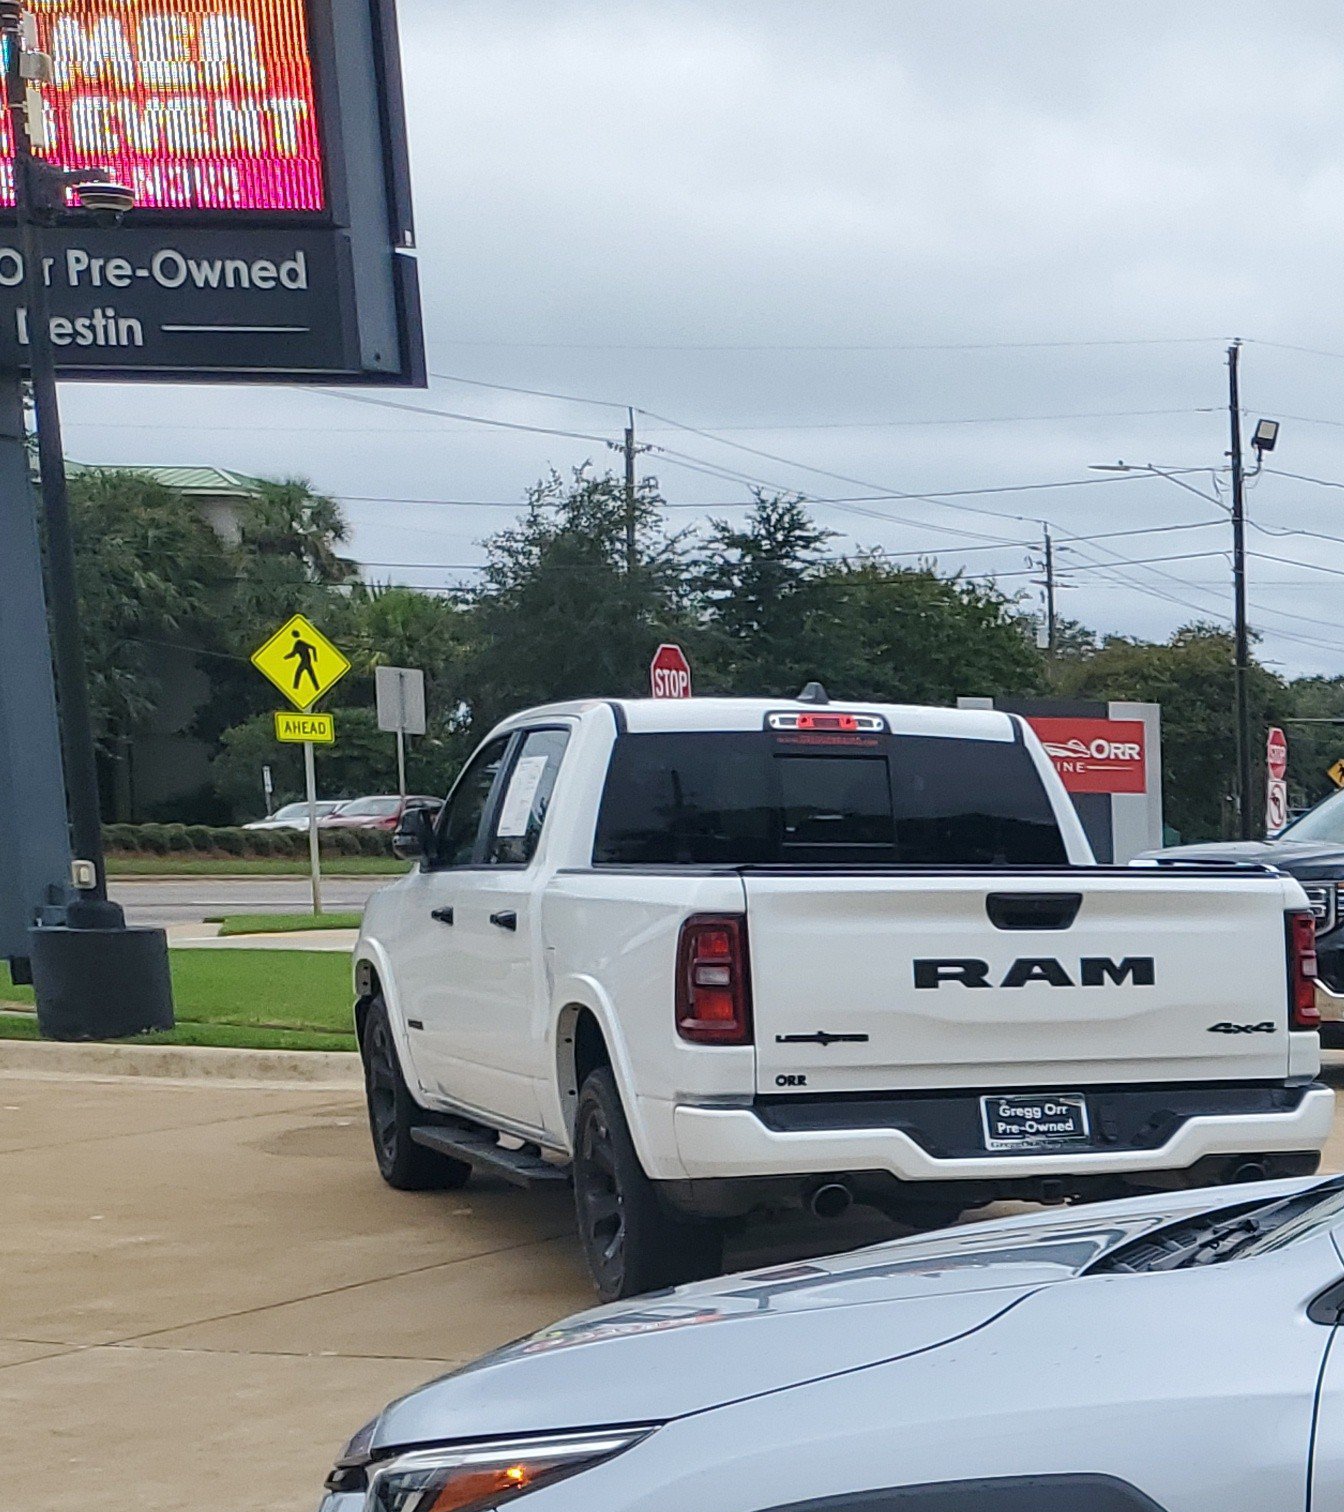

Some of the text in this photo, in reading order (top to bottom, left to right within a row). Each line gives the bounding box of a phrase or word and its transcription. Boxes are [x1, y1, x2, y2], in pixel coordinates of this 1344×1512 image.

[71, 95, 308, 155] EVENT
[0, 248, 308, 289] Or Pre-Owned
[655, 668, 688, 698] STOP
[284, 720, 327, 735] AHEAD
[1089, 738, 1141, 760] ORR
[1056, 761, 1086, 773] INE
[912, 956, 1156, 989] RAM
[1206, 1021, 1278, 1034] 4x4
[775, 1074, 807, 1087] ORR
[999, 1103, 1068, 1119] Gregg Orr
[997, 1118, 1074, 1133] Pre-Owned
